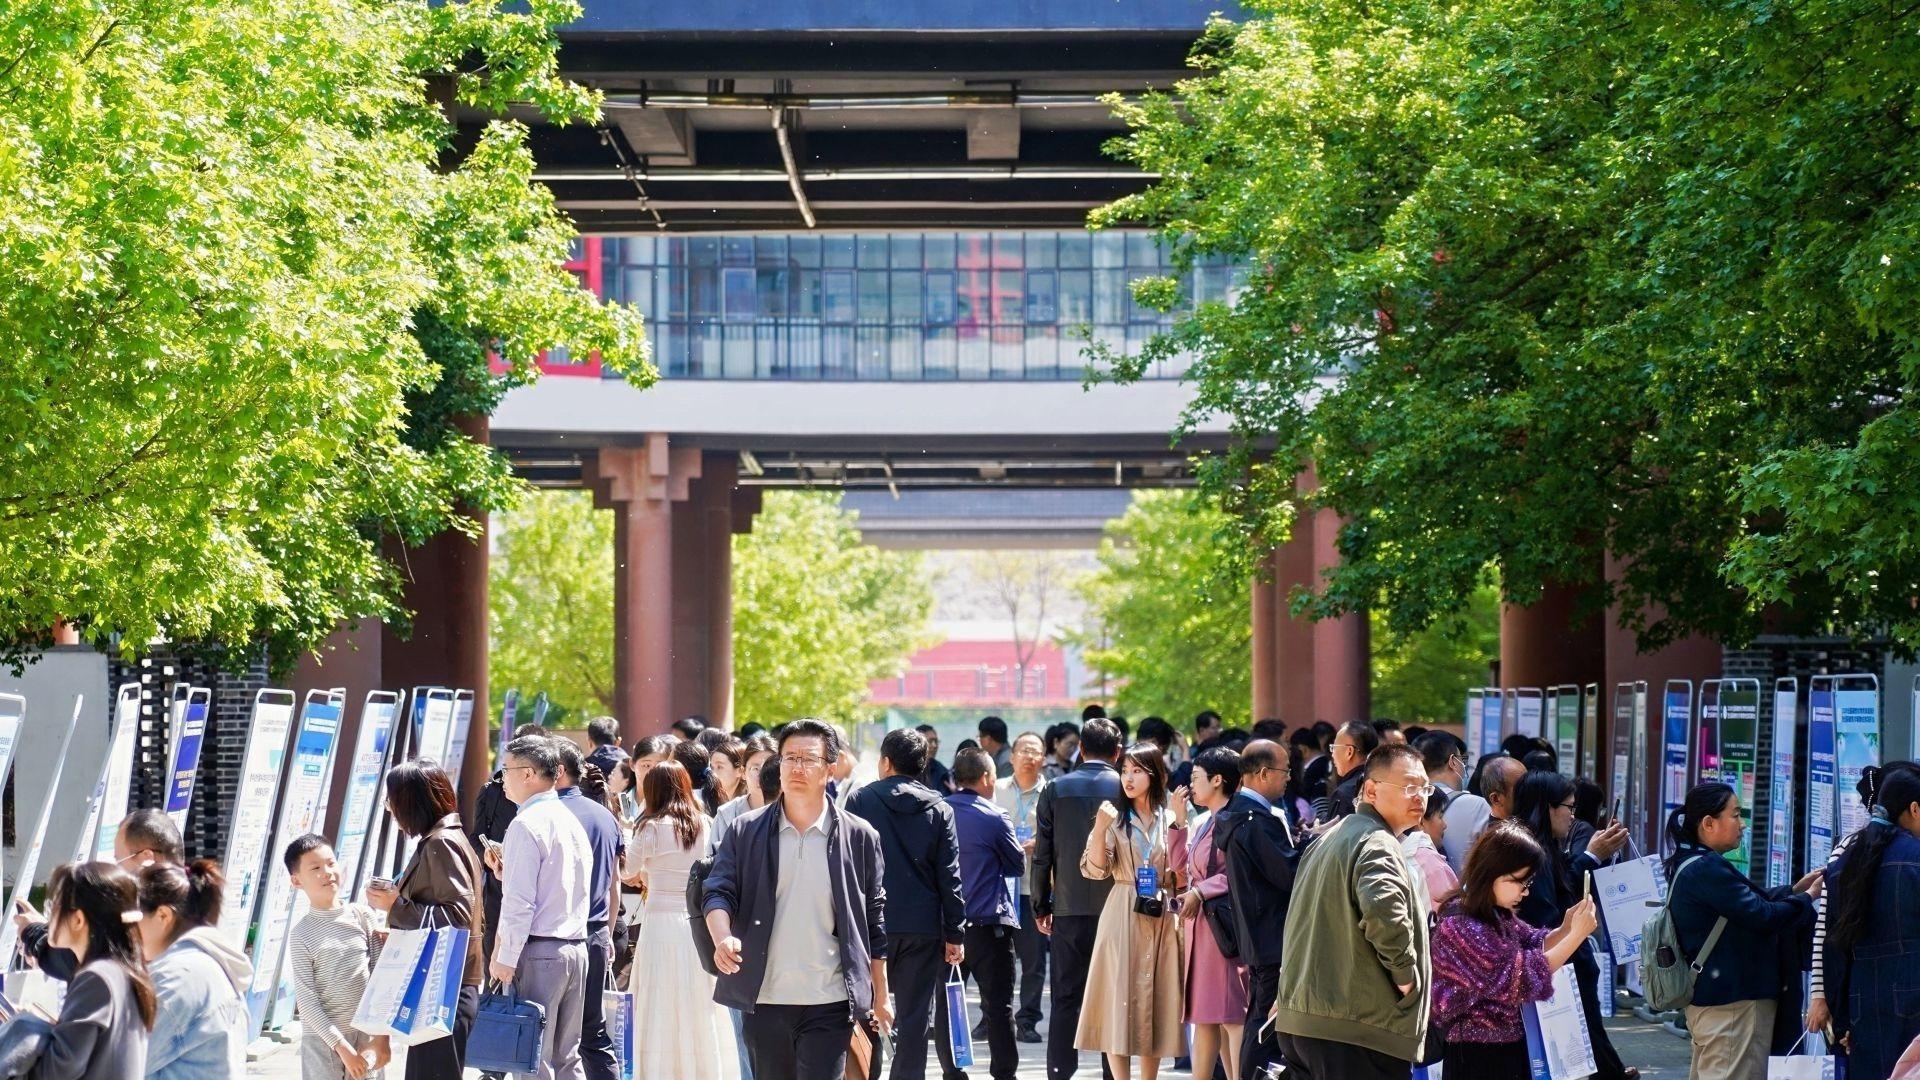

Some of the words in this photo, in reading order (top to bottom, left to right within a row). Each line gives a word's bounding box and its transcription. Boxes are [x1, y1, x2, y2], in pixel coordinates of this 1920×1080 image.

[425, 929, 448, 1026] CHEMISTRY
[1567, 967, 1596, 1071] CHEMISTRY
[614, 994, 624, 1070] EMISTRY
